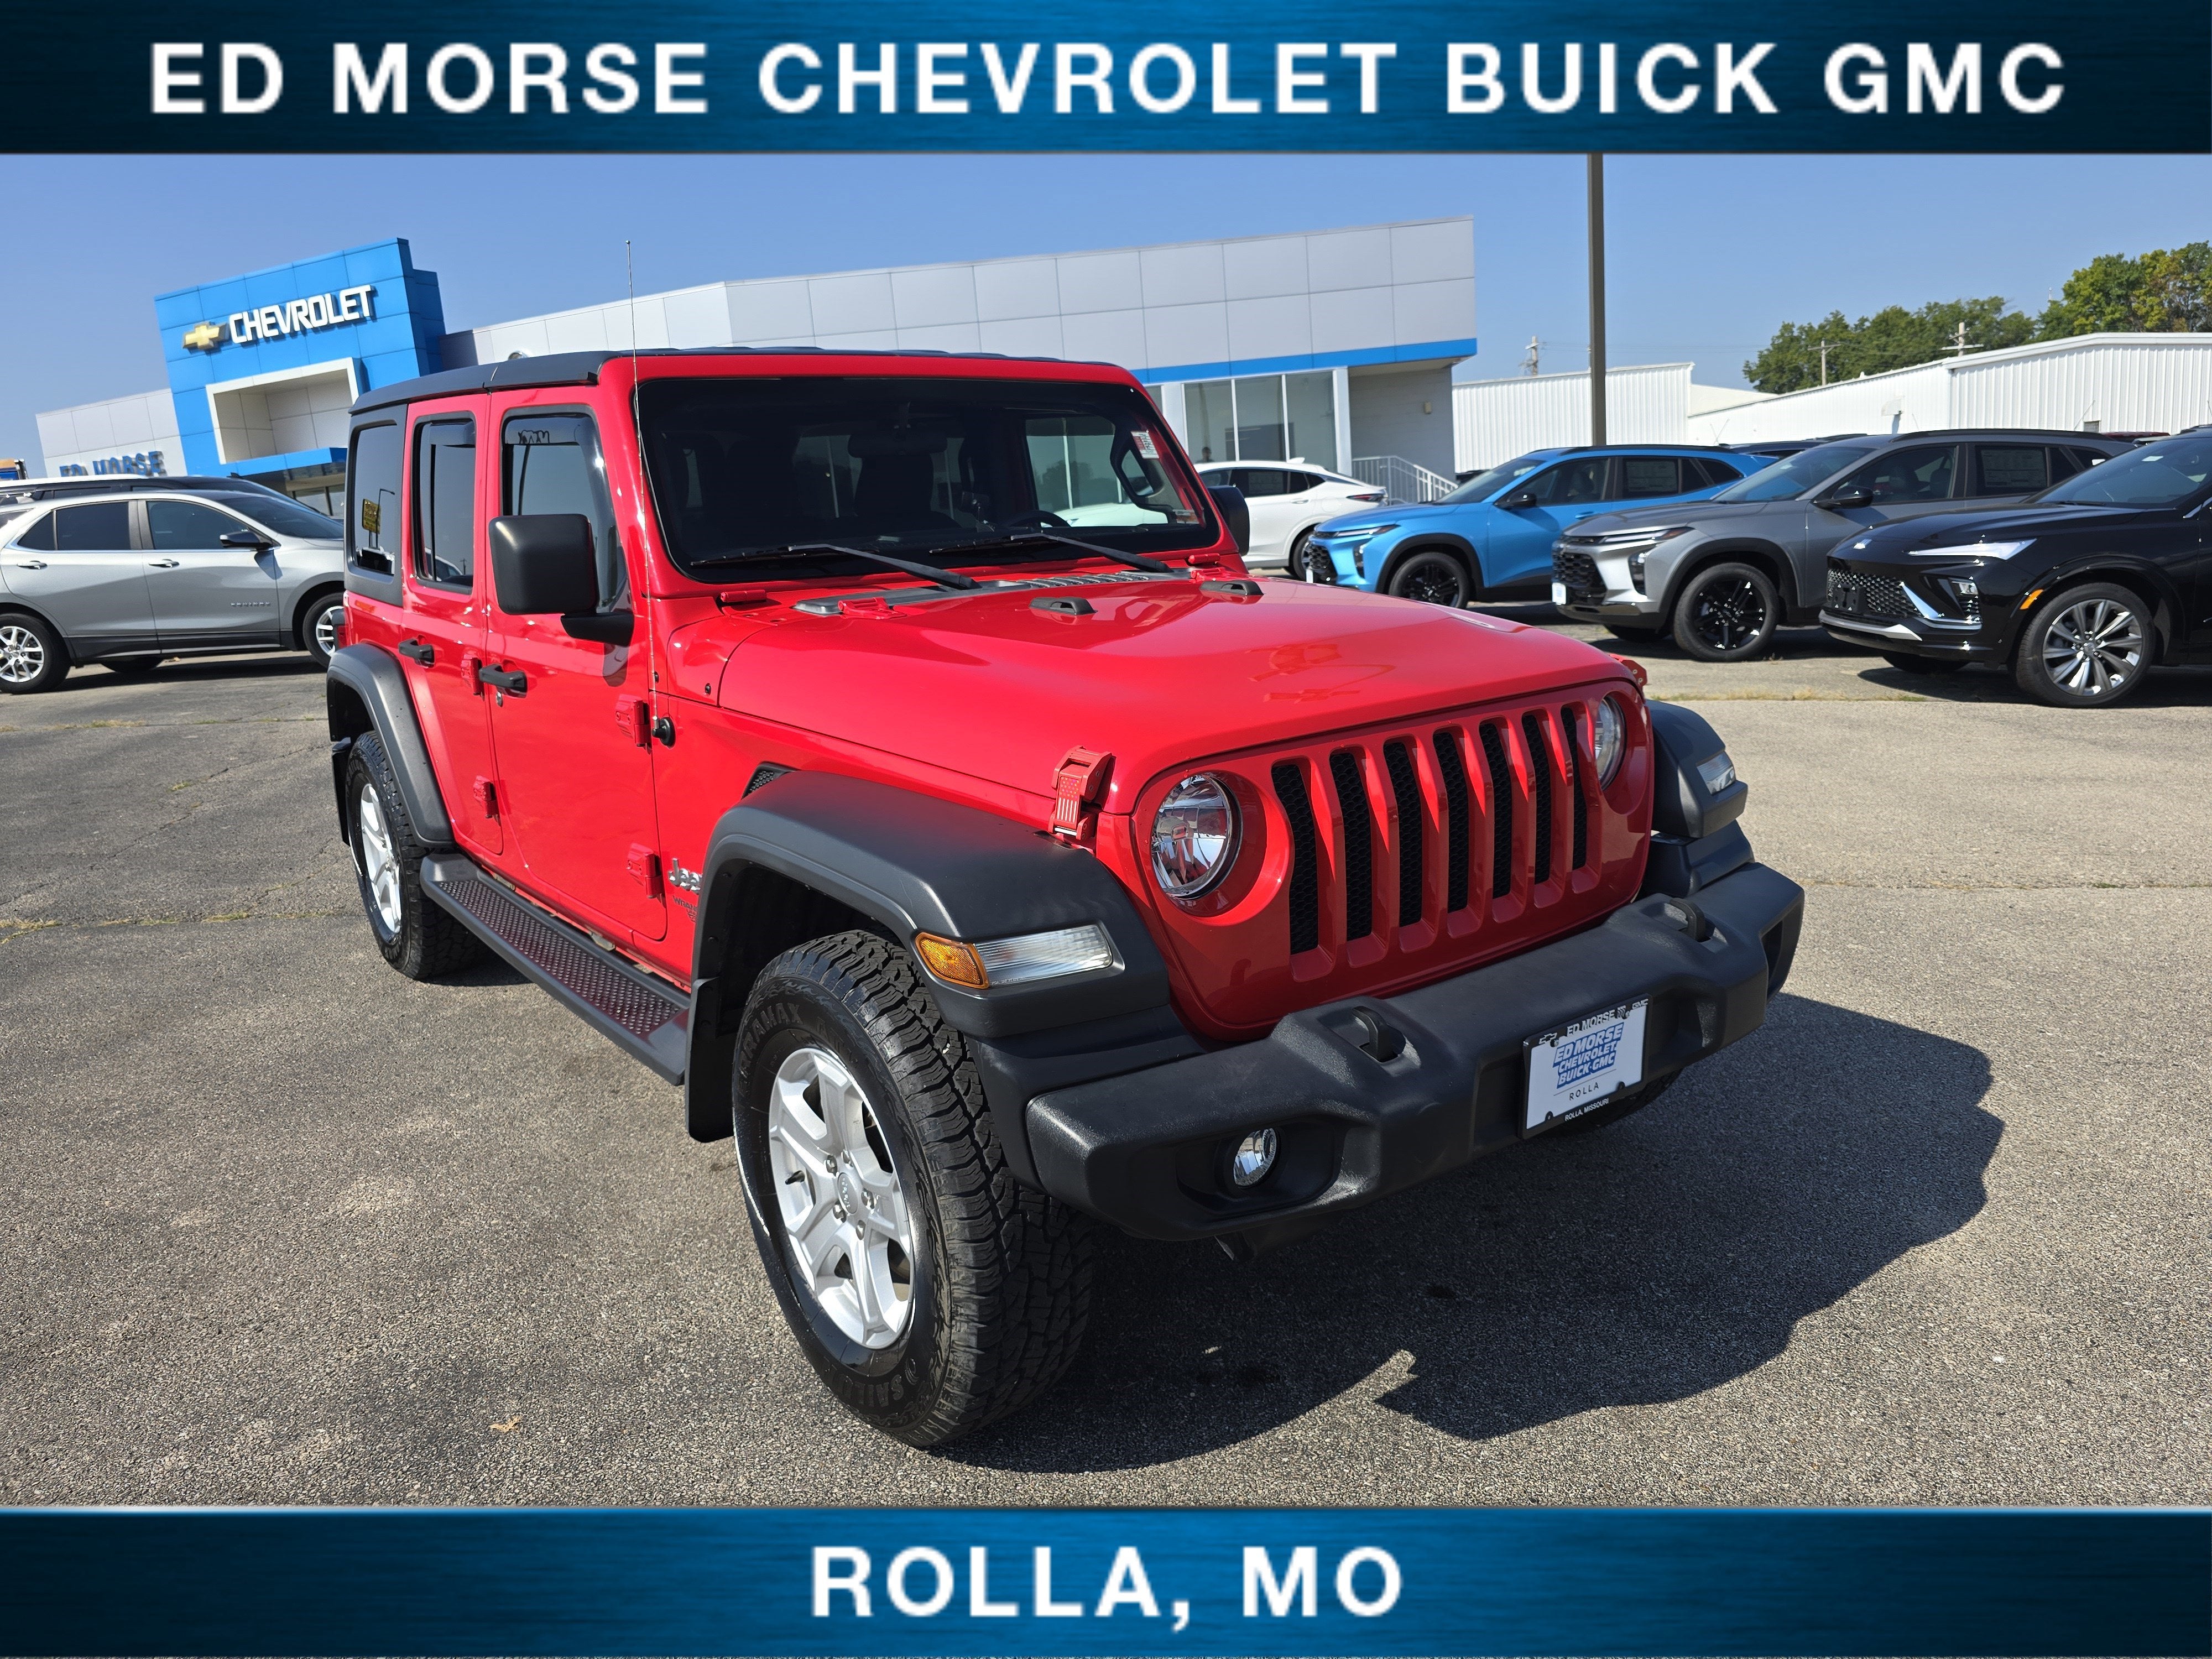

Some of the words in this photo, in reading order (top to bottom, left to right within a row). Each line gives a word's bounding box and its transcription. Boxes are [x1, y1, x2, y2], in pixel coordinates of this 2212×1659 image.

[229, 284, 372, 344] CHEVROLET
[667, 857, 703, 895] Jee
[1567, 1023, 1580, 1037] ED
[1582, 1010, 1615, 1032] MORSE
[1632, 999, 1648, 1010] GMC
[1554, 1043, 1574, 1063] ED
[1573, 1024, 1623, 1055] MORSE
[1559, 1040, 1617, 1073] CHEVROLET
[1569, 1082, 1599, 1100] ROLLA
[1584, 1098, 1609, 1113] MISSOURI
